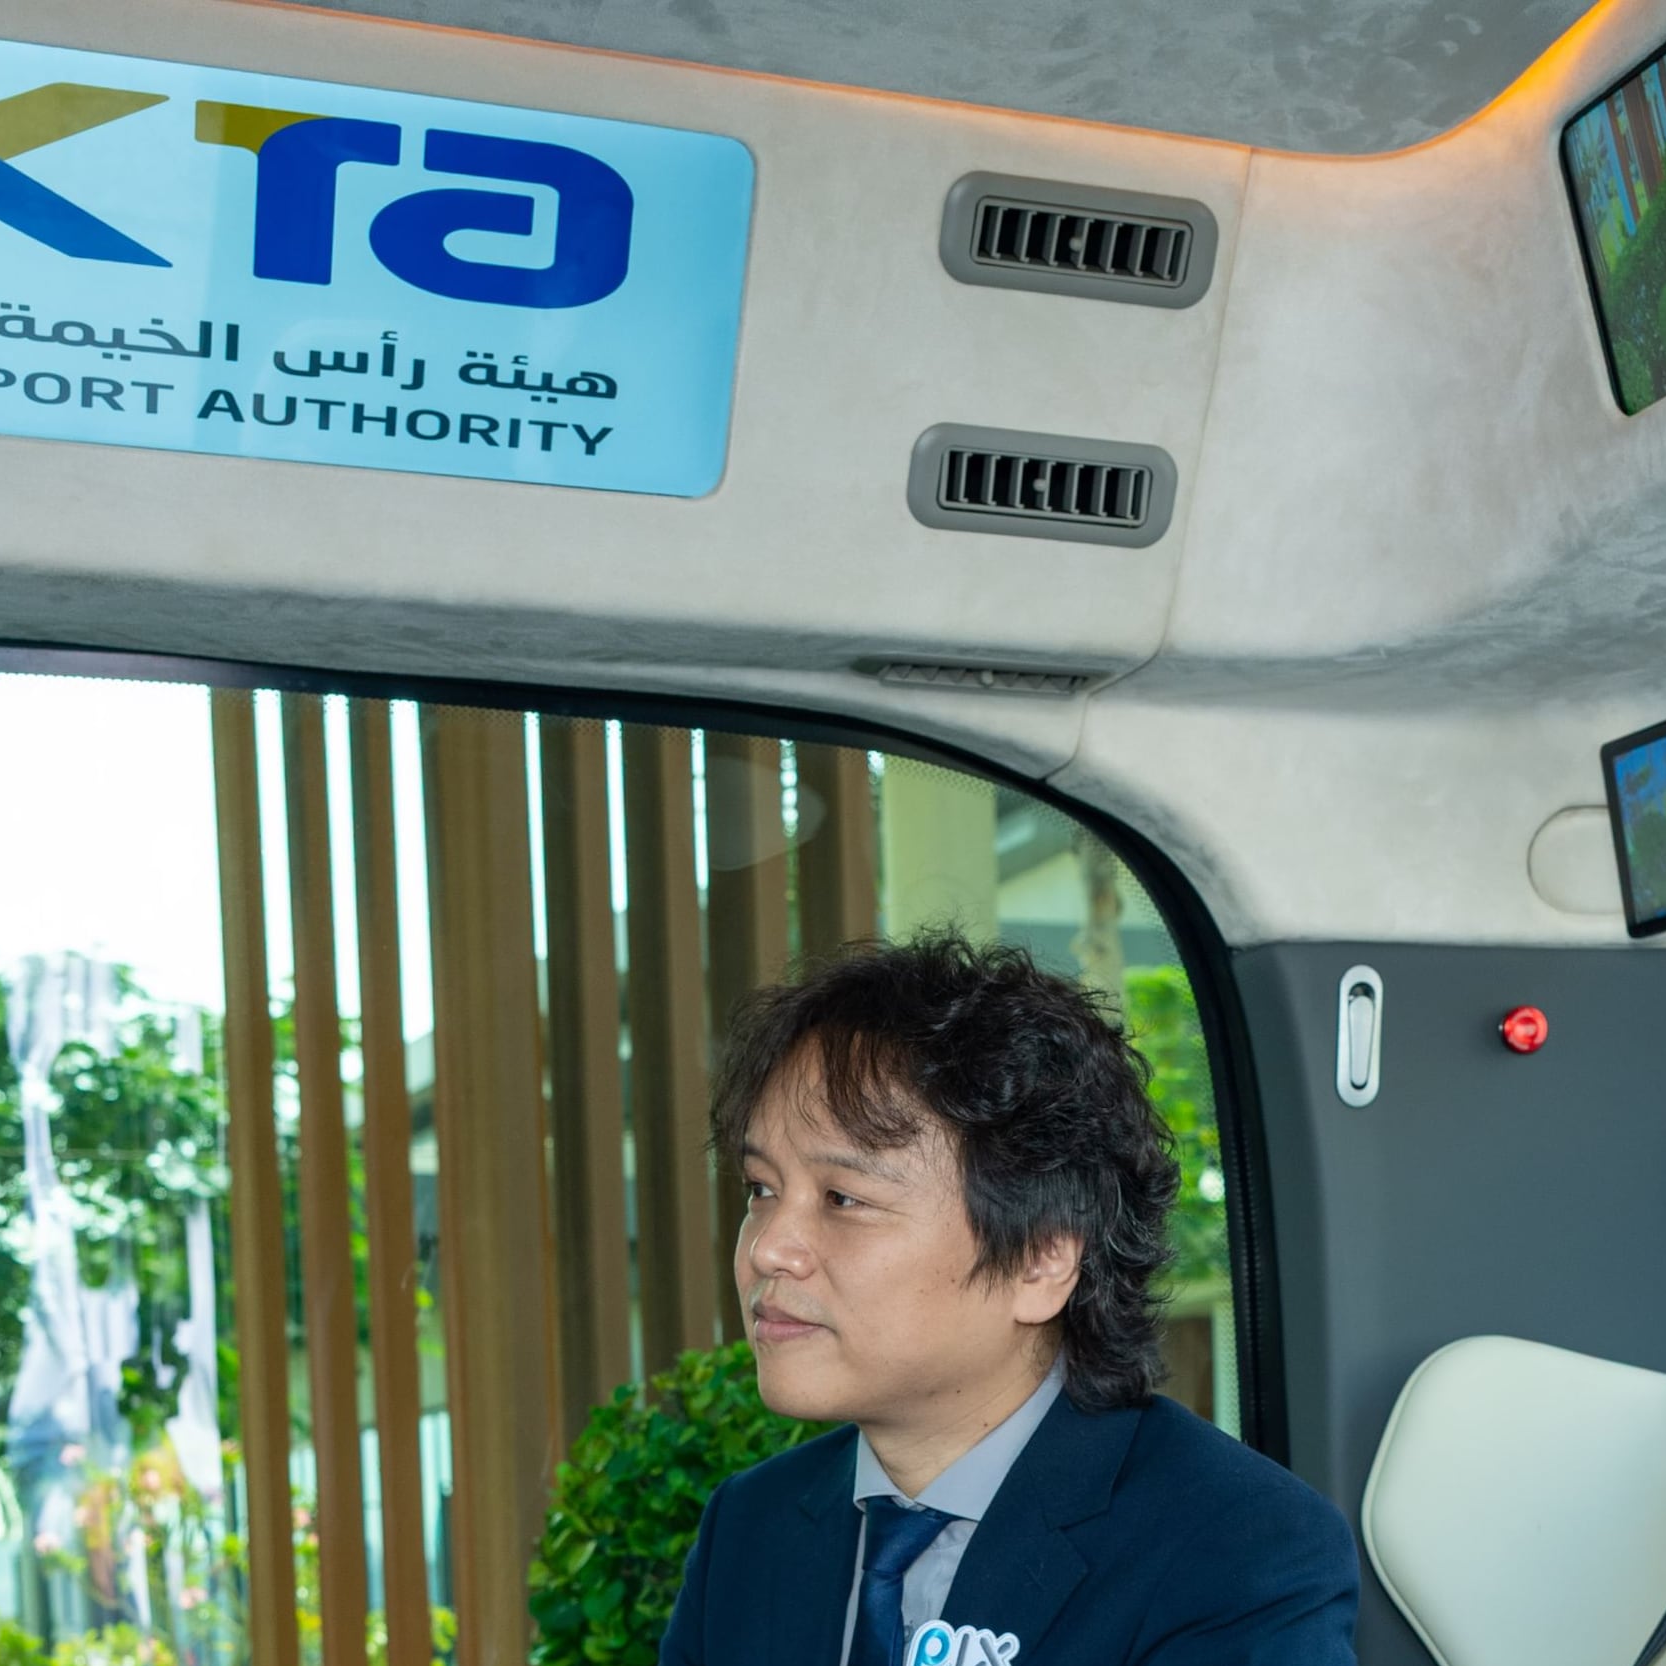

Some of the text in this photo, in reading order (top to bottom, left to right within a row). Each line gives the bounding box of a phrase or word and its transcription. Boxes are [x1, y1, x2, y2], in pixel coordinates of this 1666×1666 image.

[273, 330, 426, 391] رأس
[457, 350, 619, 404] هيئة
[196, 388, 614, 457] AUTHORITY
